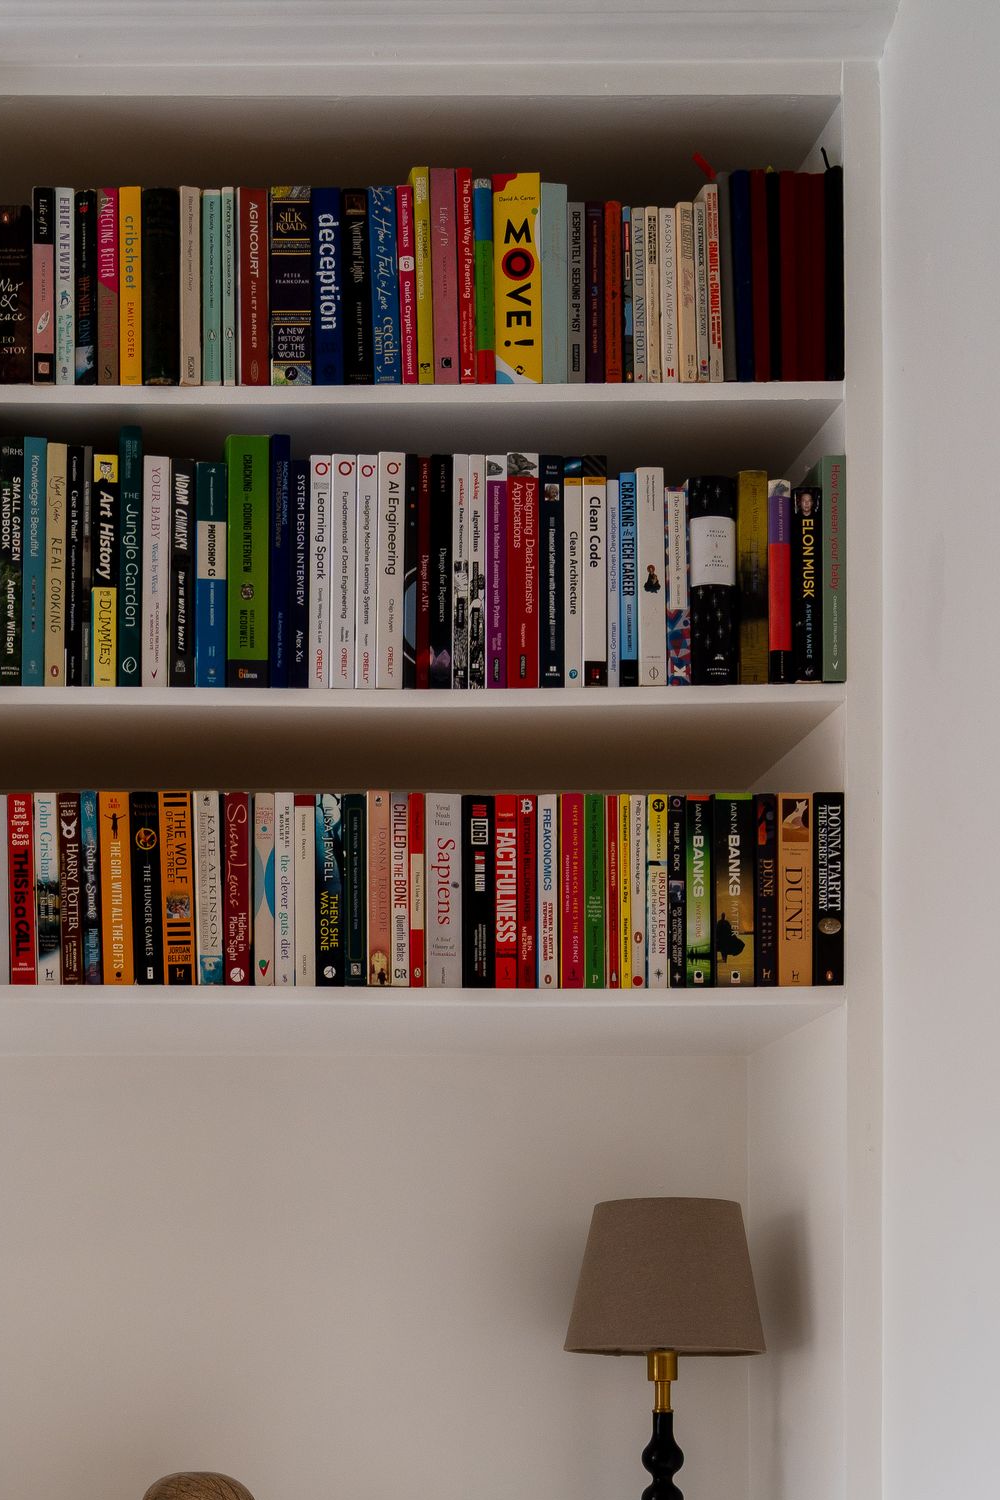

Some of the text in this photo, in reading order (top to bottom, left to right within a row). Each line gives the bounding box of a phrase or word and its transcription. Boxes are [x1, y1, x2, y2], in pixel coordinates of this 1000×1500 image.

[125, 216, 138, 289] cribsheet
[249, 202, 259, 278] AGINCOURT
[276, 222, 307, 233] ROADS
[279, 212, 302, 223] SILK
[462, 179, 473, 298] The Danish Way of Parenting
[0, 293, 18, 312] &
[316, 214, 340, 330] deception
[502, 218, 535, 347] MOVE!
[127, 302, 135, 358] EMILY OSTER
[404, 281, 414, 375] Quick Cryptic Crossword
[29, 455, 40, 505] Knowledge
[297, 474, 305, 510] SYSTEM
[2, 489, 11, 549] HANDBOOK
[12, 477, 21, 561] SMALL GARDEN
[31, 517, 40, 557] Beautiful
[97, 491, 114, 579] Art History
[207, 524, 216, 566] PHOTOSHOP
[316, 492, 327, 580] Learning Spark
[385, 481, 400, 575] AI Engineering
[590, 496, 601, 568] Clean Code
[207, 568, 216, 577] CS
[296, 552, 304, 605] INTERVIEW
[570, 531, 578, 615] Clean Architecture
[803, 519, 814, 598] ELON MUSK
[6, 580, 16, 654] Andrew Wilson
[98, 599, 112, 665] DUMMIES
[295, 630, 304, 662] Alex Xu
[143, 865, 151, 882] THE
[165, 811, 175, 884] OF WALL STREET
[174, 811, 188, 884] THE WOLF
[322, 806, 334, 882] LISA JEWELL
[543, 808, 552, 891] FREAKONOMICS
[692, 836, 705, 897] BANKS
[728, 834, 741, 897] BANKS
[818, 805, 828, 911] THE SECRET HISTORY
[828, 806, 841, 911] DONNA TARTT
[13, 849, 30, 957] THIS is a CALL
[143, 885, 153, 924] HUNGER
[431, 837, 455, 925] Sapiens
[496, 828, 516, 942] FACTFULNESS
[785, 866, 803, 941] DUNE
[320, 891, 329, 952] WAS GONE
[330, 894, 339, 948] THEN SHE
